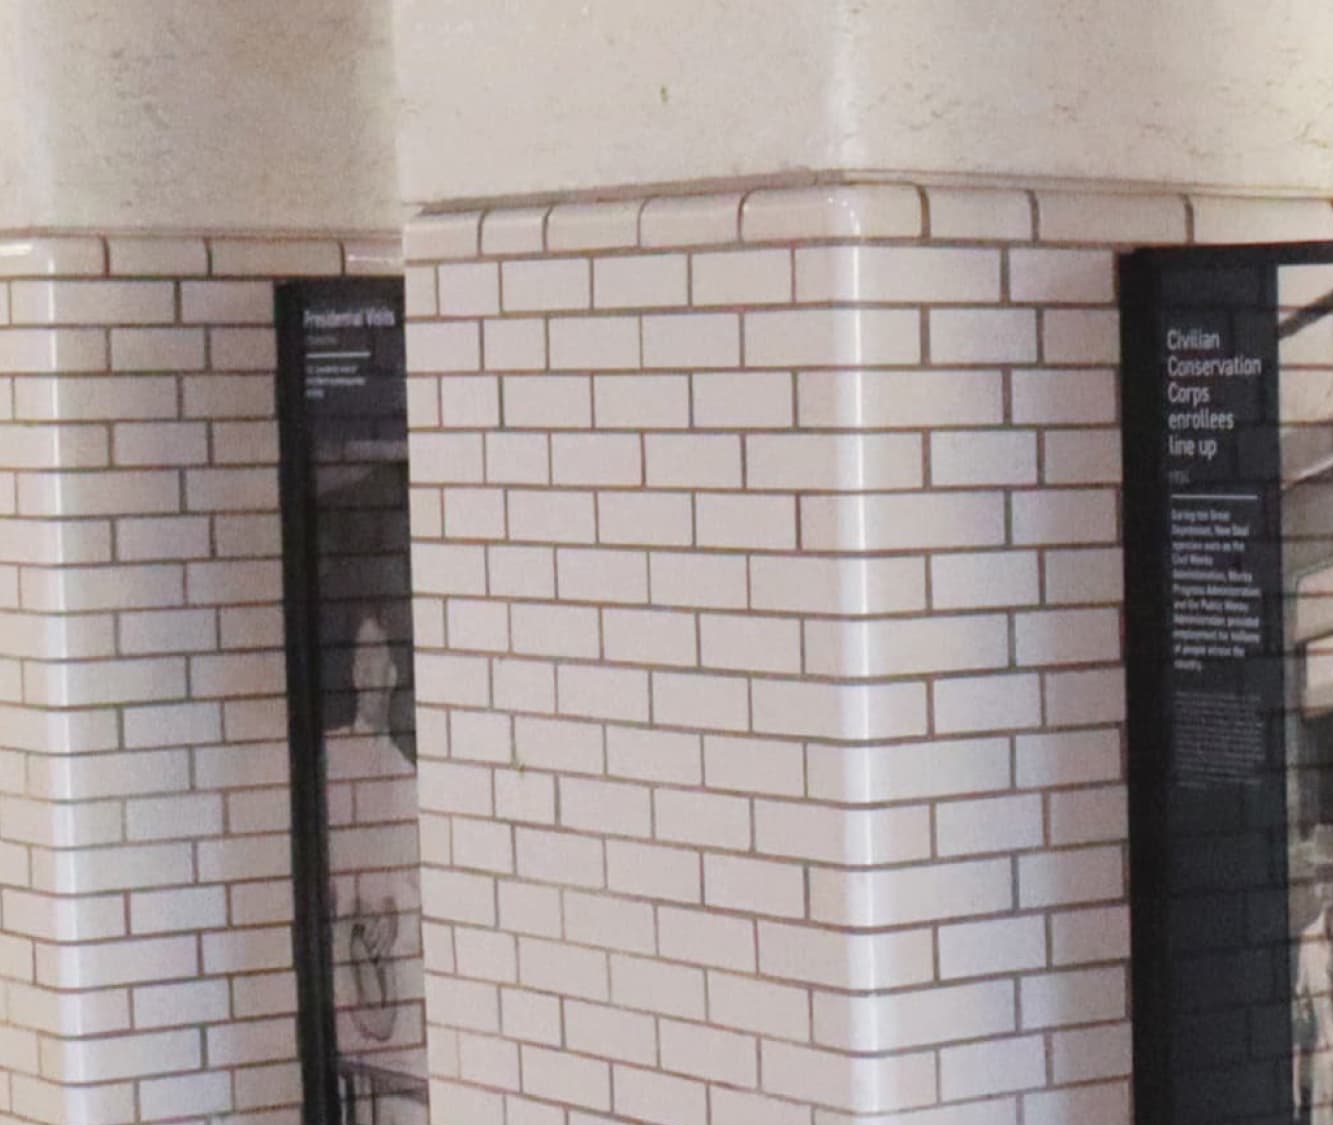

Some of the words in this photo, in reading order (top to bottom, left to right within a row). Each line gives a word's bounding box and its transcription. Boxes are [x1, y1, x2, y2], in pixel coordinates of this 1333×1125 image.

[1167, 329, 1220, 350] Civilian
[1167, 355, 1262, 377] Conservation
[1168, 381, 1210, 408] Corps
[1168, 408, 1235, 429] enrollees
[1169, 435, 1195, 455] line
[1198, 438, 1218, 460] up
